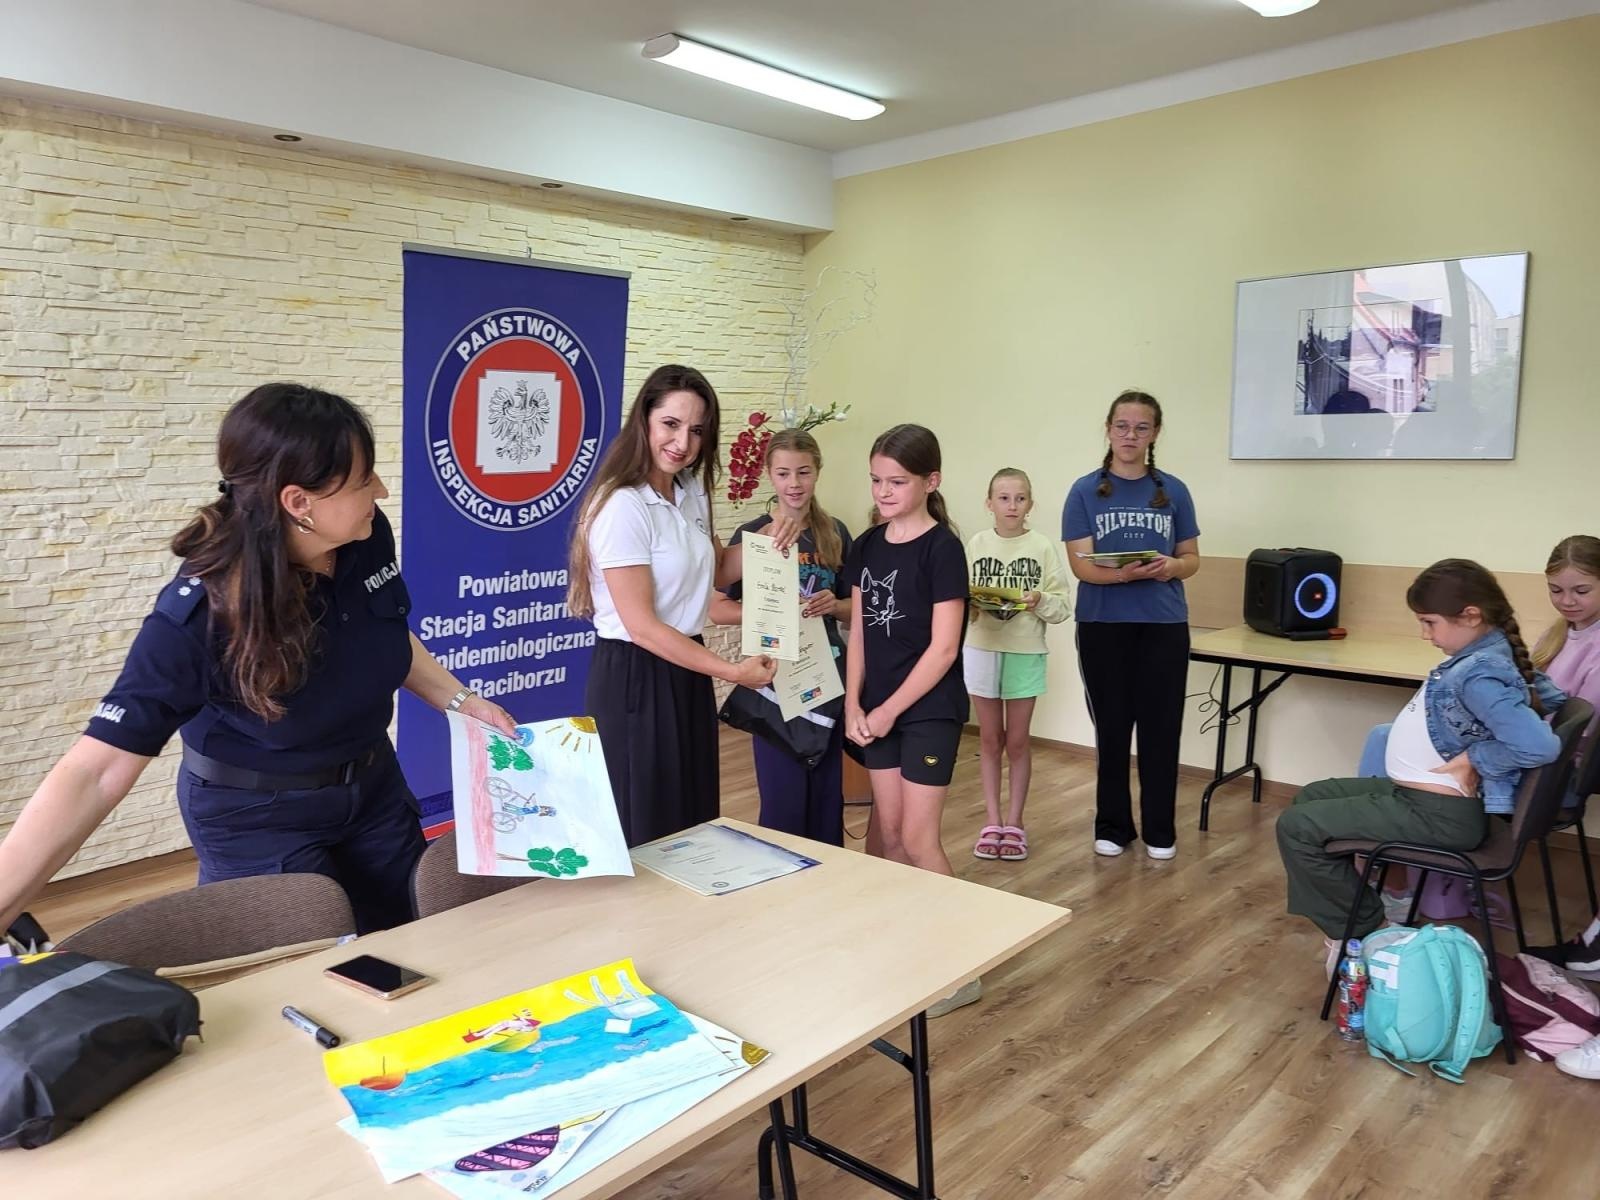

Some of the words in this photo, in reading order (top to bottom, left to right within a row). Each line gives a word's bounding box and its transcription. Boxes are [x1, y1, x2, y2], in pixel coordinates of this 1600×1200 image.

[456, 315, 581, 366] PAŃSTWOWA
[433, 439, 513, 525] INSPEKCJA
[518, 437, 598, 525] SANITARNA
[1095, 512, 1172, 541] SILVERTON
[364, 560, 399, 593] POLICJ
[973, 557, 1005, 576] TRUE
[458, 568, 568, 599] Powiatowa
[420, 610, 486, 641] Stacja
[492, 601, 573, 629] Sanitarn
[430, 630, 596, 671] pidemiologiczna
[468, 666, 567, 699] Raciborzu
